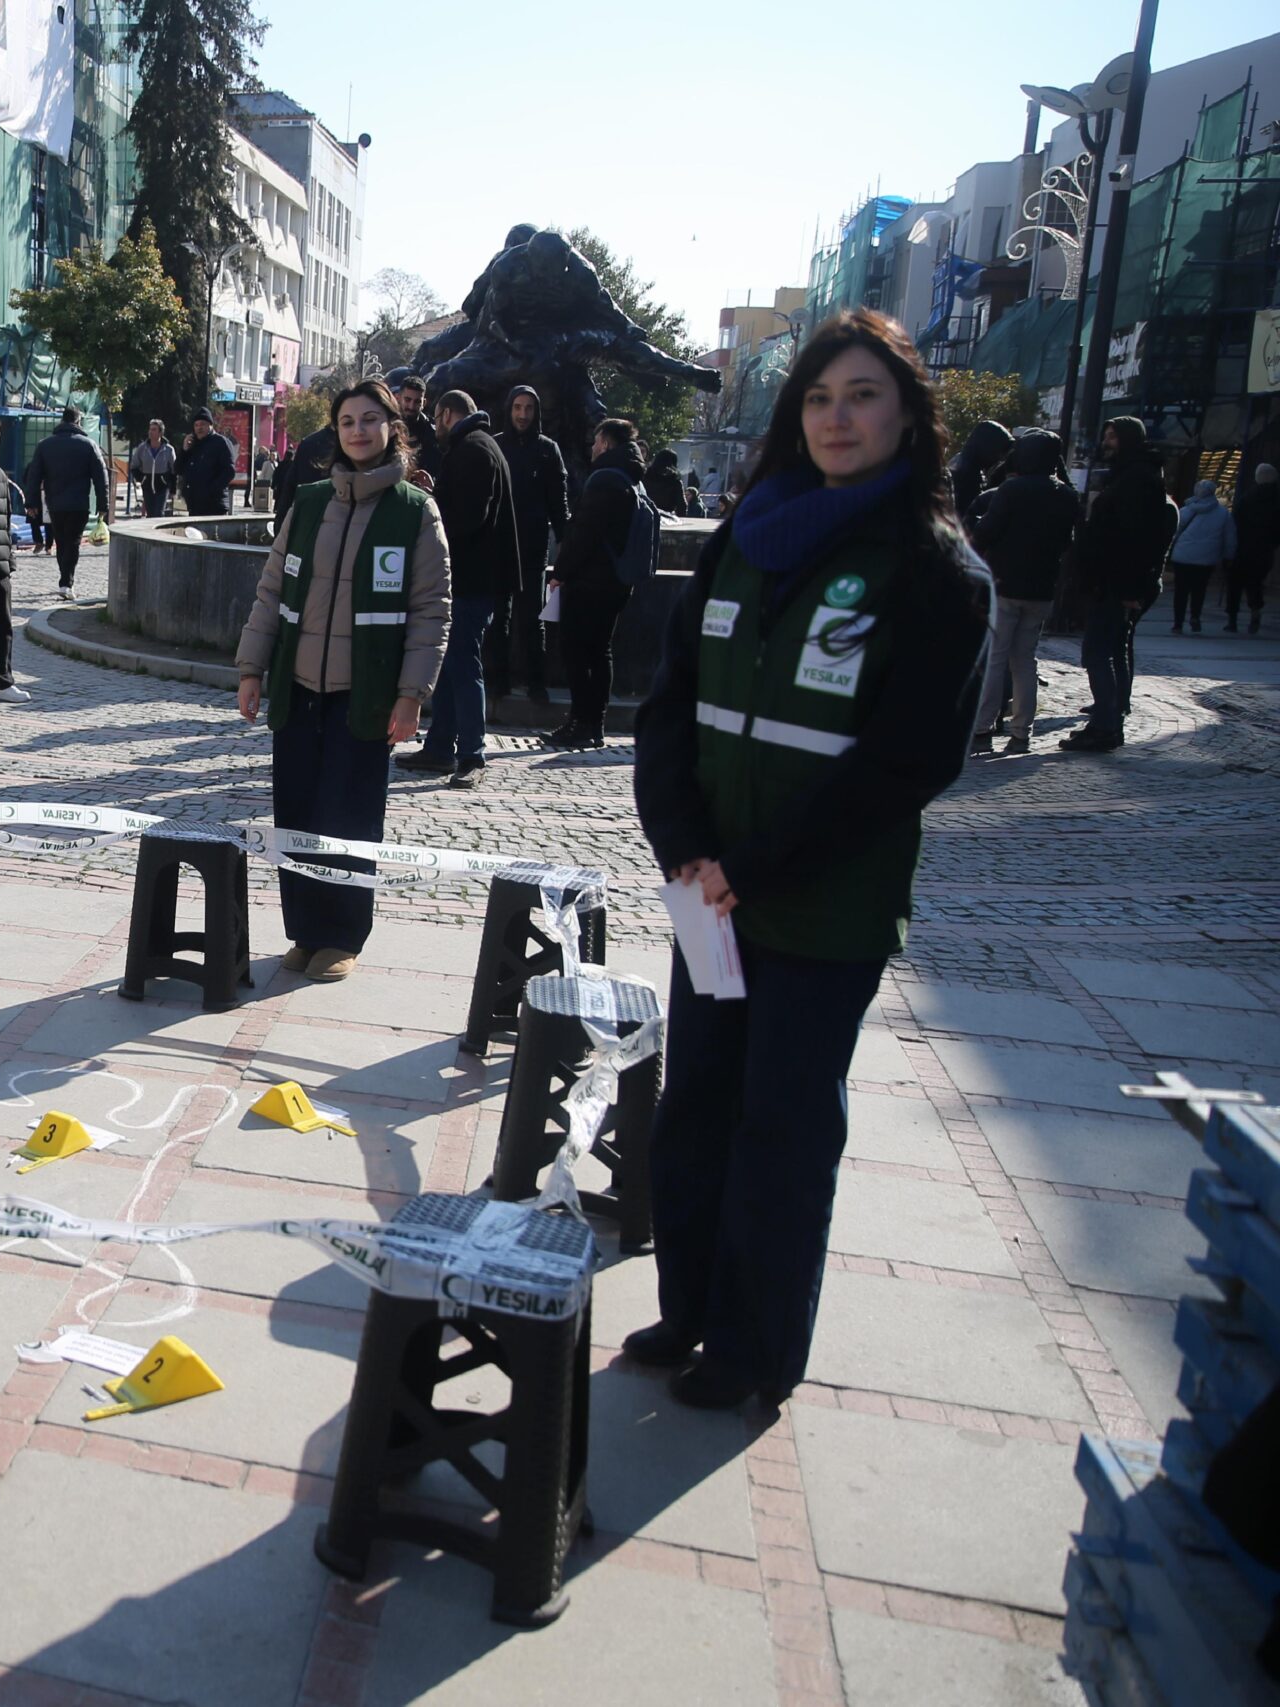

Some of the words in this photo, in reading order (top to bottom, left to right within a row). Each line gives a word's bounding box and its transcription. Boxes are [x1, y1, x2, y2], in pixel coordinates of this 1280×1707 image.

[292, 1095, 303, 1114] 1
[43, 1123, 57, 1143] 3
[143, 1357, 164, 1383] 2
